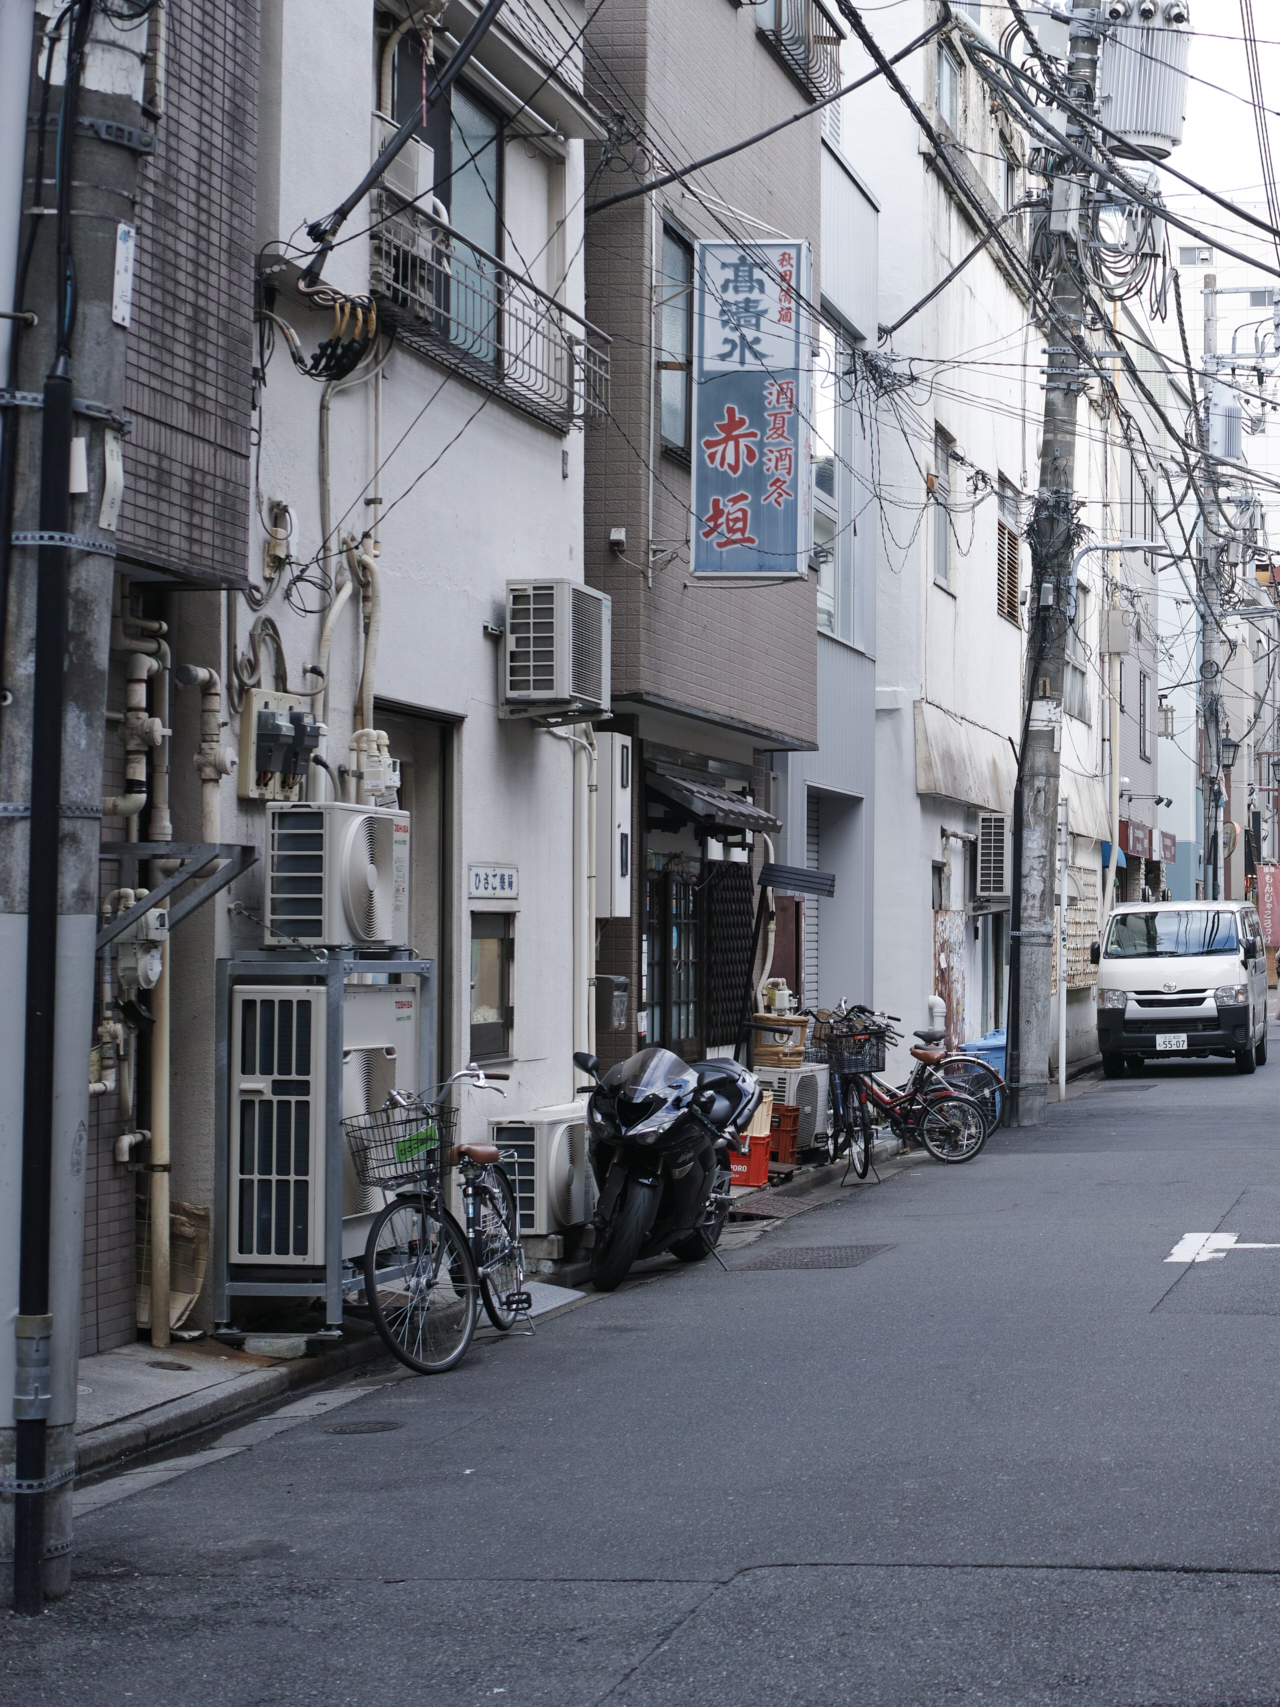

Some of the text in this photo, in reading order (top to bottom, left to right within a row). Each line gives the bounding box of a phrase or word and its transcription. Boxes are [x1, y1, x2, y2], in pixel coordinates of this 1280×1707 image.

[777, 252, 794, 323] 秋田清酒
[702, 405, 759, 550] 赤垣
[474, 872, 513, 891] ひさご薬局
[1163, 1039, 1186, 1049] 55-07
